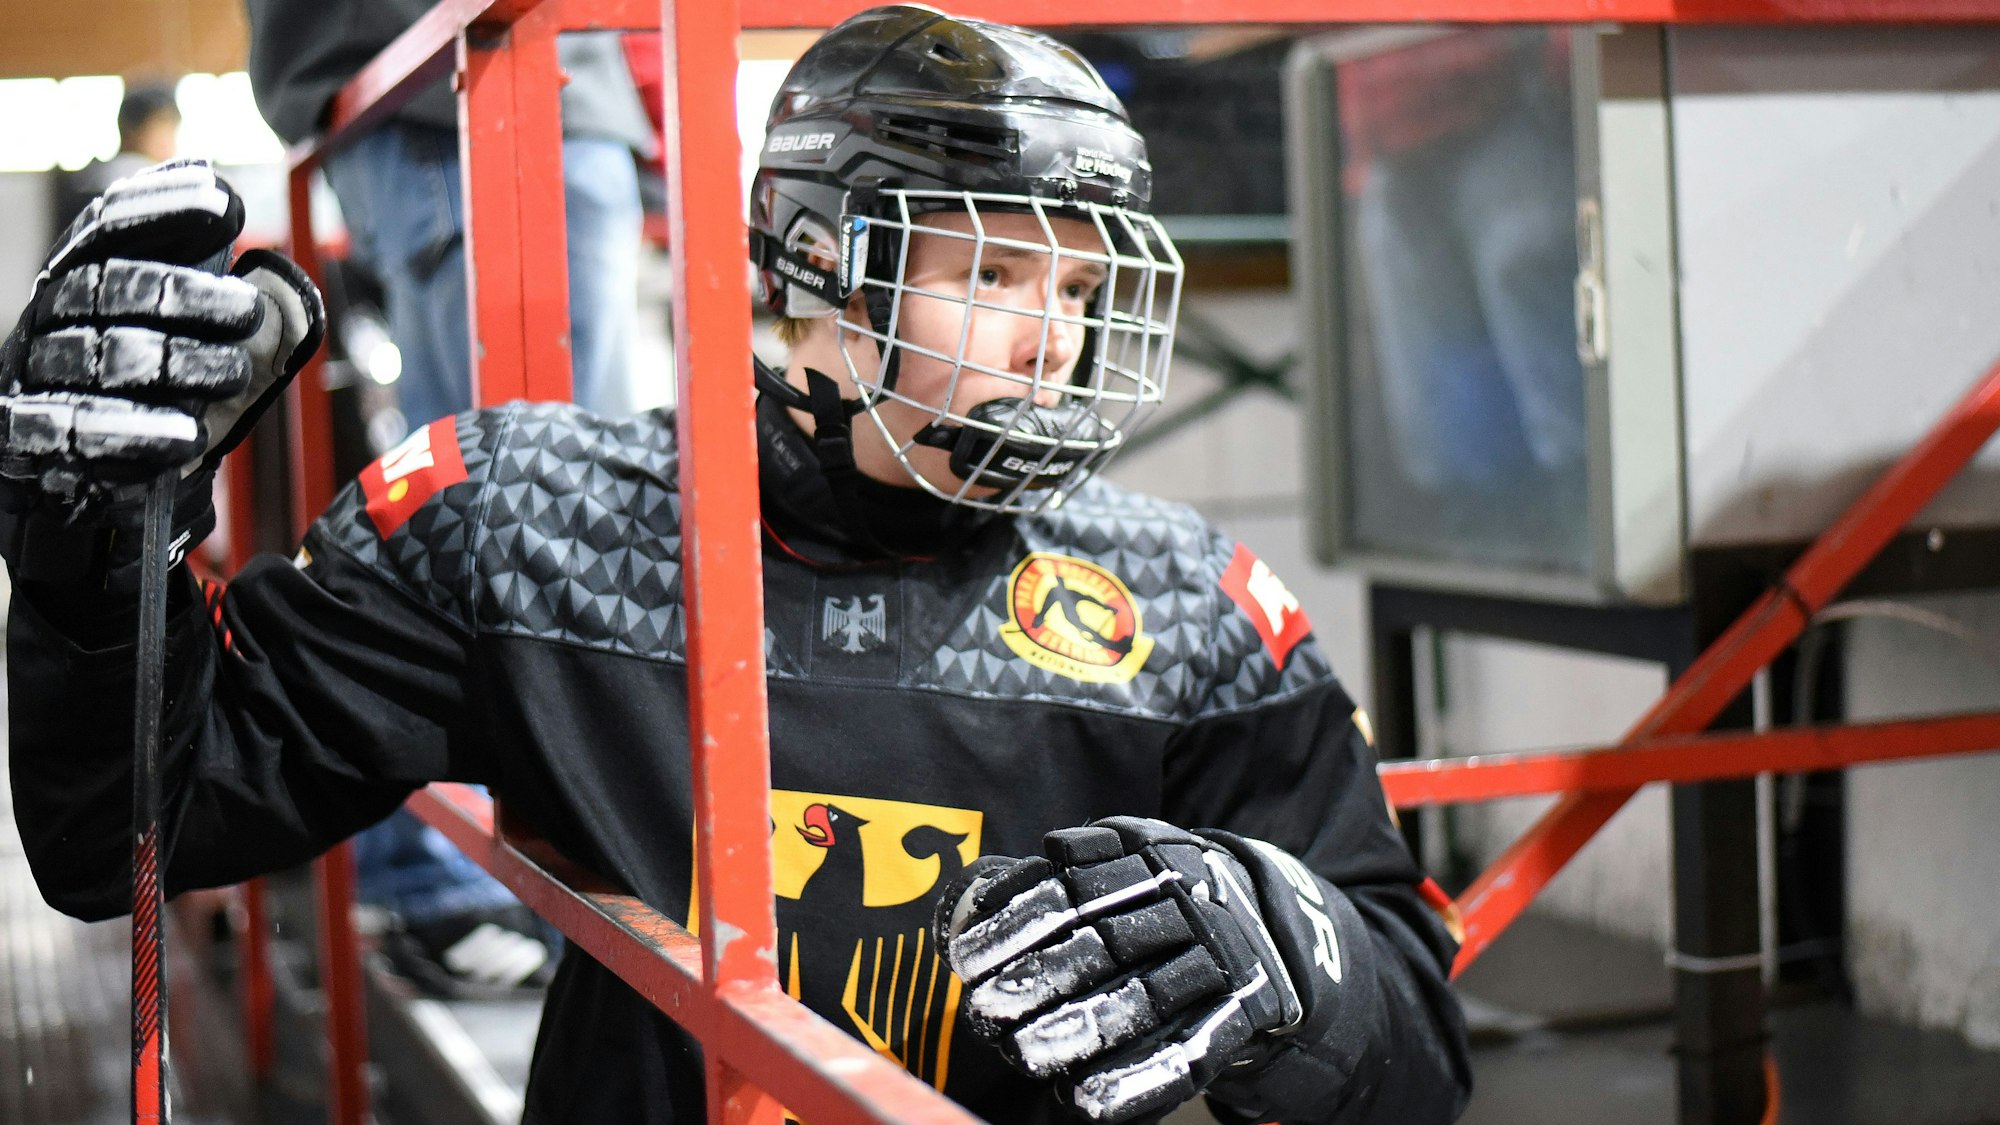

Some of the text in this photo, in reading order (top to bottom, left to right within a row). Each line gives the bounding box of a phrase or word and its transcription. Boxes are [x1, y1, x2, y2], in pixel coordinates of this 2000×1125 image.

[768, 132, 836, 153] BAUER
[775, 257, 826, 290] BAUER
[841, 233, 850, 289] BAUER
